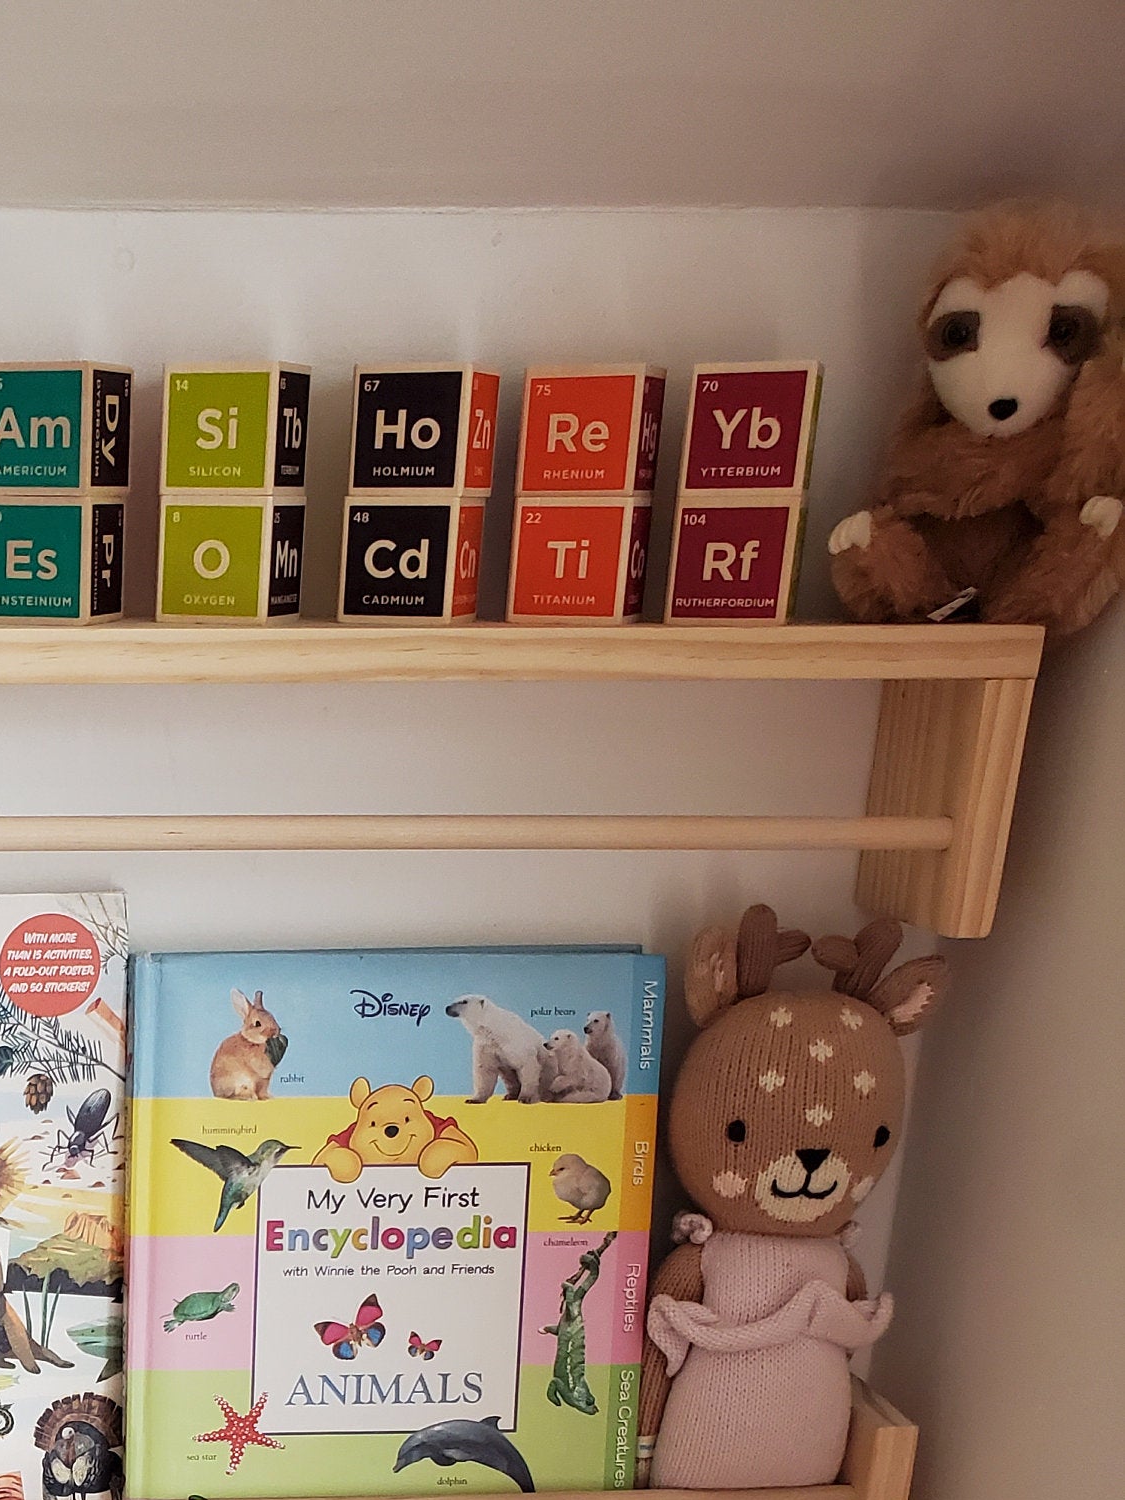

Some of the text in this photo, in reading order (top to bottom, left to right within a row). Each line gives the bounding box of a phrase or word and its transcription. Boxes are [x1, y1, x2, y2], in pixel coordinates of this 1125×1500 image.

[175, 380, 189, 392] 14
[364, 380, 380, 392] 67
[535, 384, 551, 396] 75
[702, 380, 719, 392] 70
[195, 406, 239, 450] Si
[375, 409, 441, 450] Ho
[546, 413, 610, 453] Re
[713, 406, 781, 449] Yb
[189, 466, 241, 476] SILICON
[373, 466, 435, 477] HOLMIUM
[543, 468, 605, 480] RHENIUM
[701, 466, 781, 478] YTTERBIUM
[173, 512, 181, 523] 8
[353, 512, 369, 524] 48
[525, 512, 541, 524] 22
[683, 514, 706, 526] 104
[5, 540, 58, 580] Es
[193, 539, 231, 579] O
[363, 538, 430, 580] Cd
[547, 540, 590, 580] Ti
[703, 539, 761, 582] Rf
[183, 594, 235, 606] OXYGEN
[362, 594, 425, 606] CADMIUM
[533, 594, 595, 606] TITANIUM
[675, 597, 775, 608] RUTHERFORDIUM
[24, 933, 77, 944] WITH MORE
[10, 983, 91, 992] AND 50 STICKERS!
[531, 1006, 575, 1018] polar bears
[640, 980, 658, 1070] Mammals
[280, 1074, 305, 1084] rabbit
[202, 1124, 257, 1138] hummingbird
[529, 1143, 561, 1153] chicken
[633, 1140, 649, 1186] Birds
[307, 1186, 479, 1214] My Very First
[265, 1214, 517, 1260] Encyclopedia
[543, 1238, 589, 1248] chameleon
[283, 1262, 495, 1277] with Winnie the Pooh and Friends
[623, 1262, 641, 1332] Reptiles
[185, 1332, 207, 1341] turtle
[285, 1372, 484, 1408] ANIMALS
[613, 1370, 635, 1488] Sea Creatures
[436, 1476, 467, 1488] dolphin
